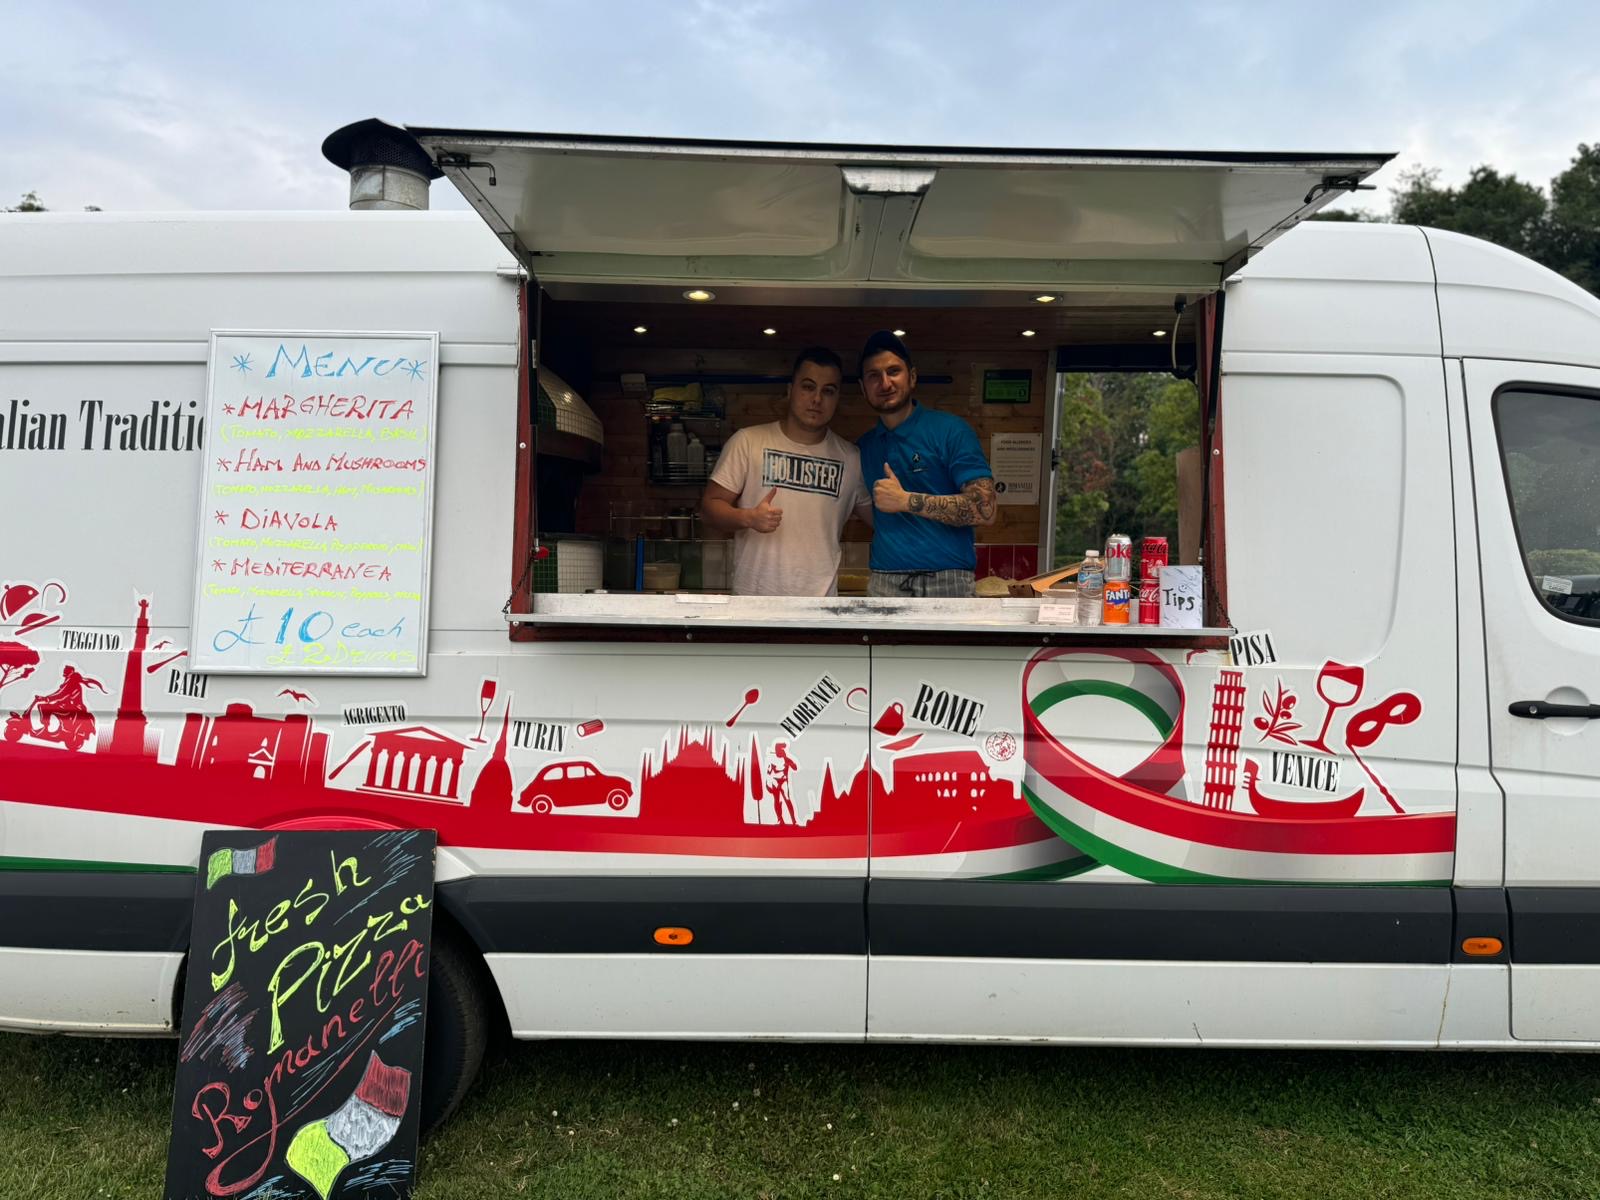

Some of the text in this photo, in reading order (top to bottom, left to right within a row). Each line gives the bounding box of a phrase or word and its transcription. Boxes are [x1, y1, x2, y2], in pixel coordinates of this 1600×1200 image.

[237, 394, 414, 420] MARGHERITA
[0, 400, 67, 450] lian
[768, 455, 838, 489] HOLLISTER
[1162, 589, 1194, 611] Tips
[63, 630, 120, 651] TEGGIANO
[341, 617, 405, 638] each
[1230, 633, 1277, 666] PISA
[168, 669, 208, 699] BARI
[343, 705, 406, 726] AGRIGENTO
[780, 675, 842, 738] FLORENCE
[912, 683, 984, 738] ROME
[513, 720, 567, 752] TURIN
[1271, 752, 1339, 792] VENICE
